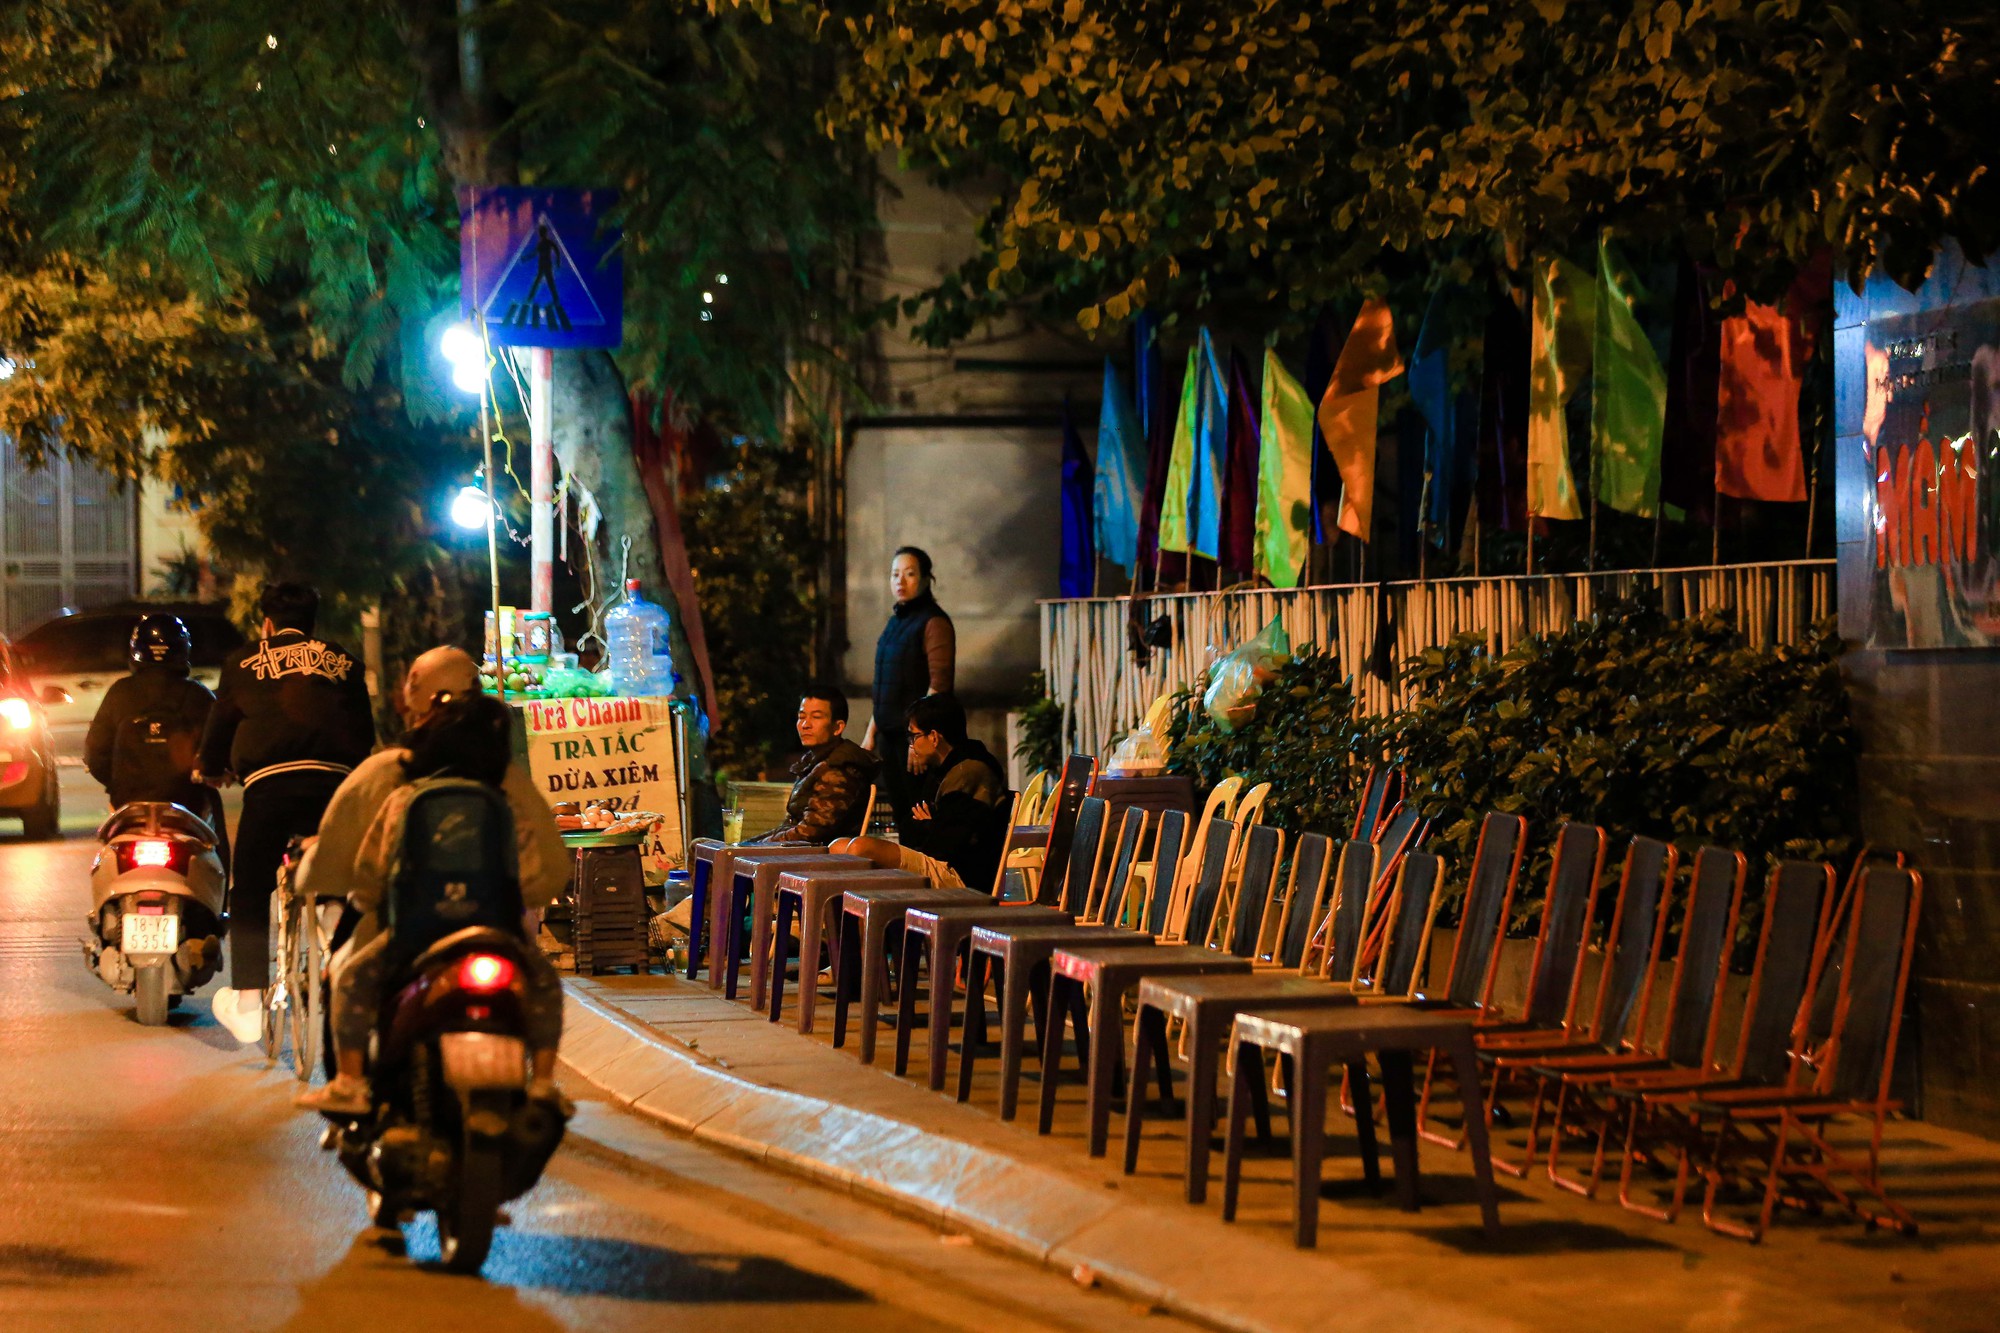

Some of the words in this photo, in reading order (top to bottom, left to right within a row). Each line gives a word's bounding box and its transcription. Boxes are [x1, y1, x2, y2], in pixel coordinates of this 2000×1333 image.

[528, 698, 568, 731] Trà
[572, 697, 643, 728] Chanh
[550, 735, 597, 761] TRÀ
[600, 728, 645, 756] TẮC
[547, 768, 597, 793] DỪA
[603, 761, 660, 787] XIÊM
